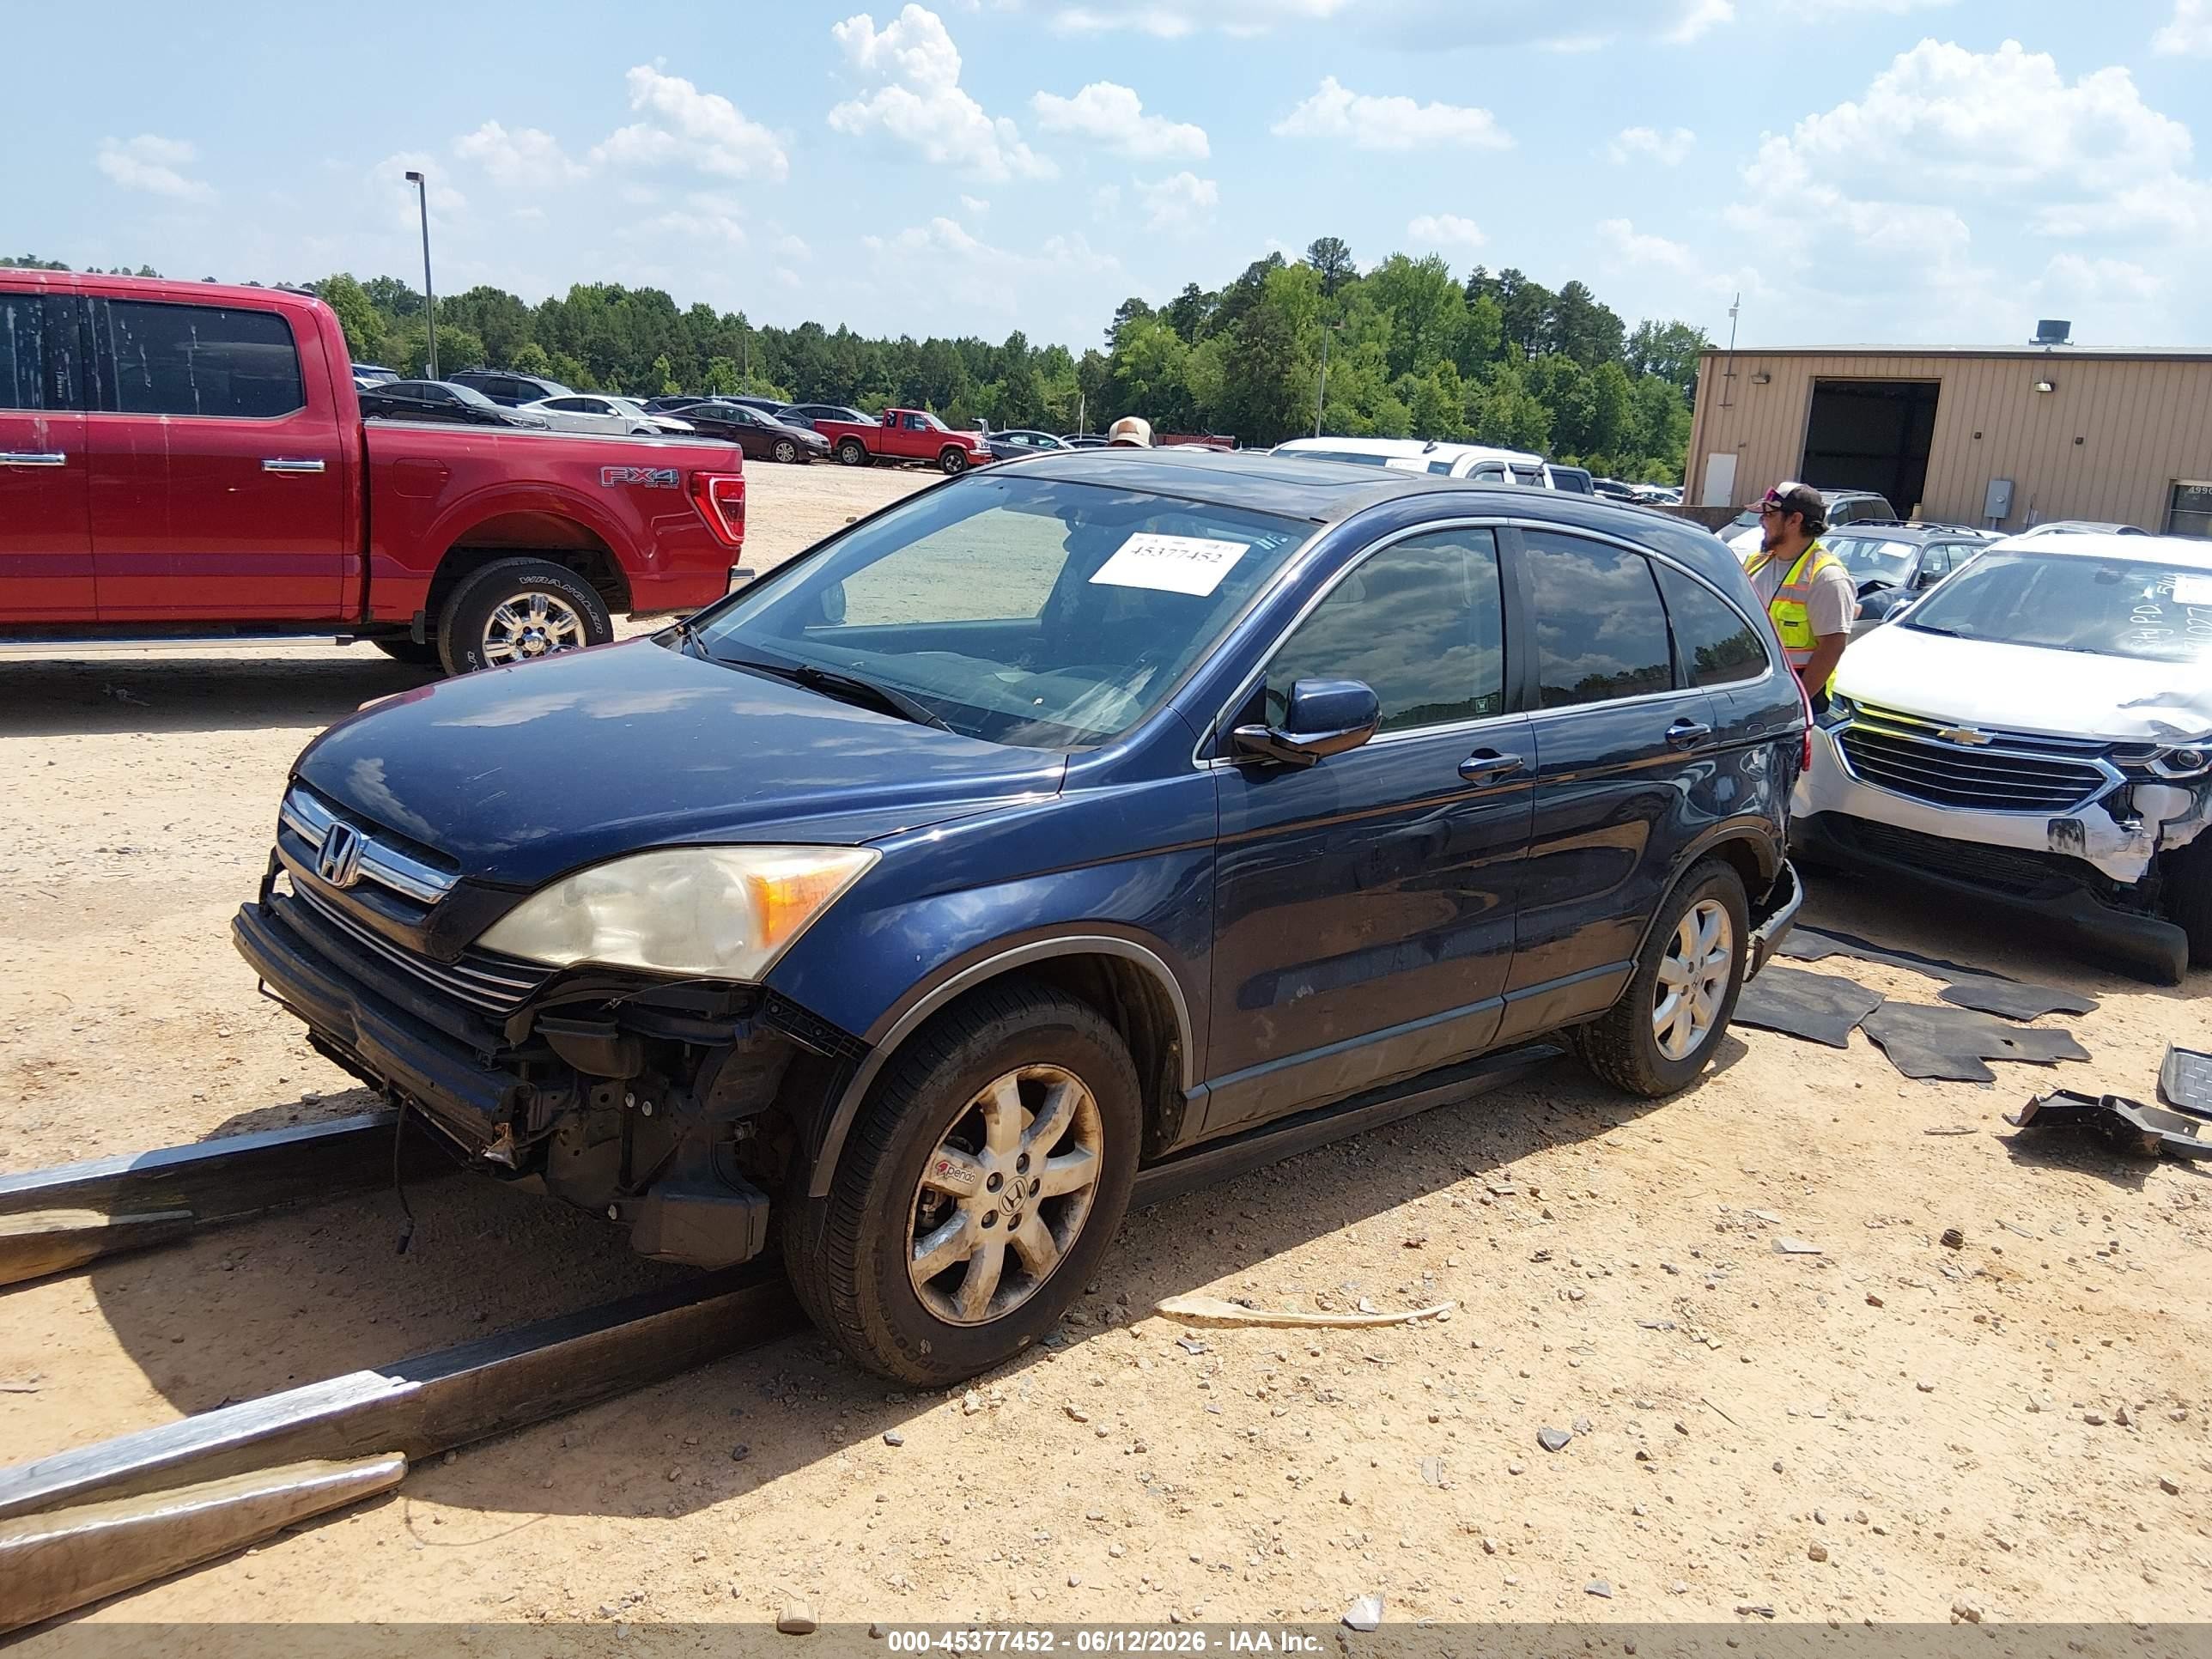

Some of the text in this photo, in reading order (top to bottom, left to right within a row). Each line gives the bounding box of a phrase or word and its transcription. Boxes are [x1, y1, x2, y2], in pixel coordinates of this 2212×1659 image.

[599, 466, 680, 487] FX4
[1132, 546, 1222, 562] 45377452
[520, 576, 603, 634] WRANGLER
[2130, 604, 2163, 623] P.D.
[946, 1167, 975, 1182] pendo
